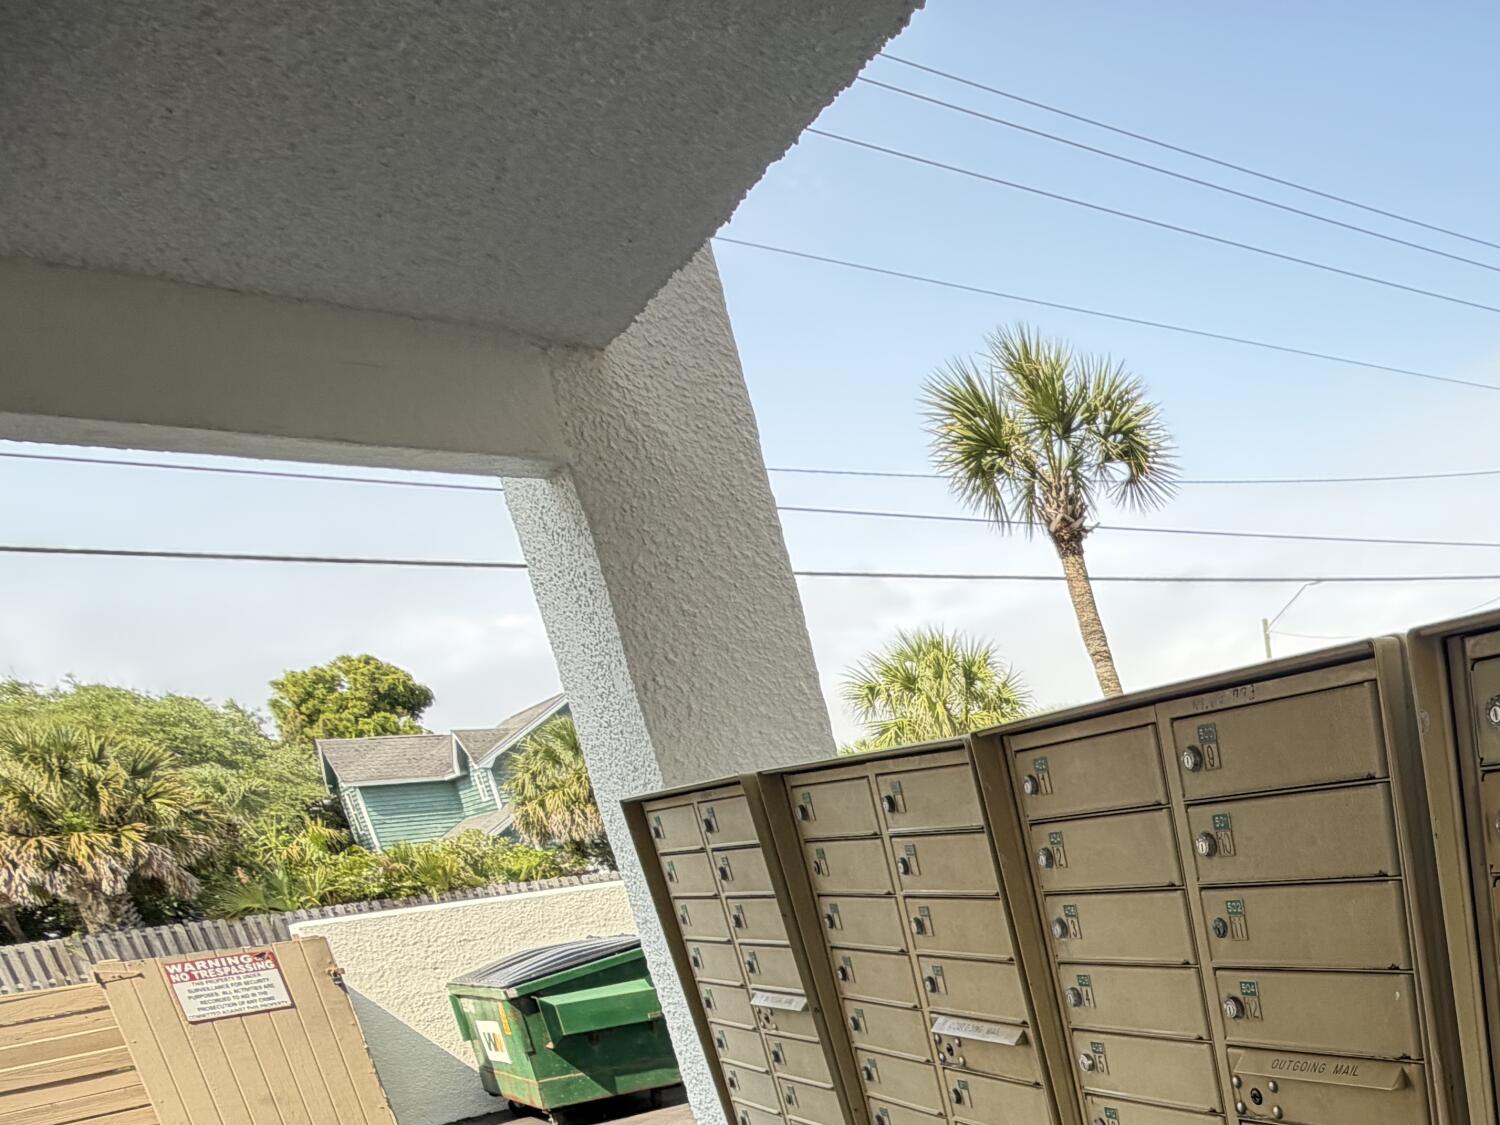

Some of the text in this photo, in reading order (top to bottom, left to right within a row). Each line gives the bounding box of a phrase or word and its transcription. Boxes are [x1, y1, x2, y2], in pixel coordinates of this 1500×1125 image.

[1041, 775, 1048, 793] 1
[1056, 847, 1063, 867] 2
[1226, 901, 1243, 914] 502
[1071, 919, 1078, 938] 3
[165, 954, 253, 974] WARNING
[170, 959, 275, 983] NO TRESPASSING
[187, 983, 230, 994] SURVEILLANCE
[243, 977, 270, 987] SECURITY
[205, 975, 236, 985] PROPERTY
[1240, 982, 1256, 995] 504
[233, 985, 263, 995] ACTIVITIES
[1084, 989, 1091, 1008] 4
[197, 1002, 238, 1012] PROSECUTION
[258, 995, 276, 1003] CRIME
[200, 996, 232, 1005] RECORDED
[259, 1000, 289, 1010] PROPERTY
[1245, 997, 1258, 1021] 12
[1098, 1055, 1105, 1073] 5
[1271, 1058, 1360, 1077] OUTGOING MAIL
